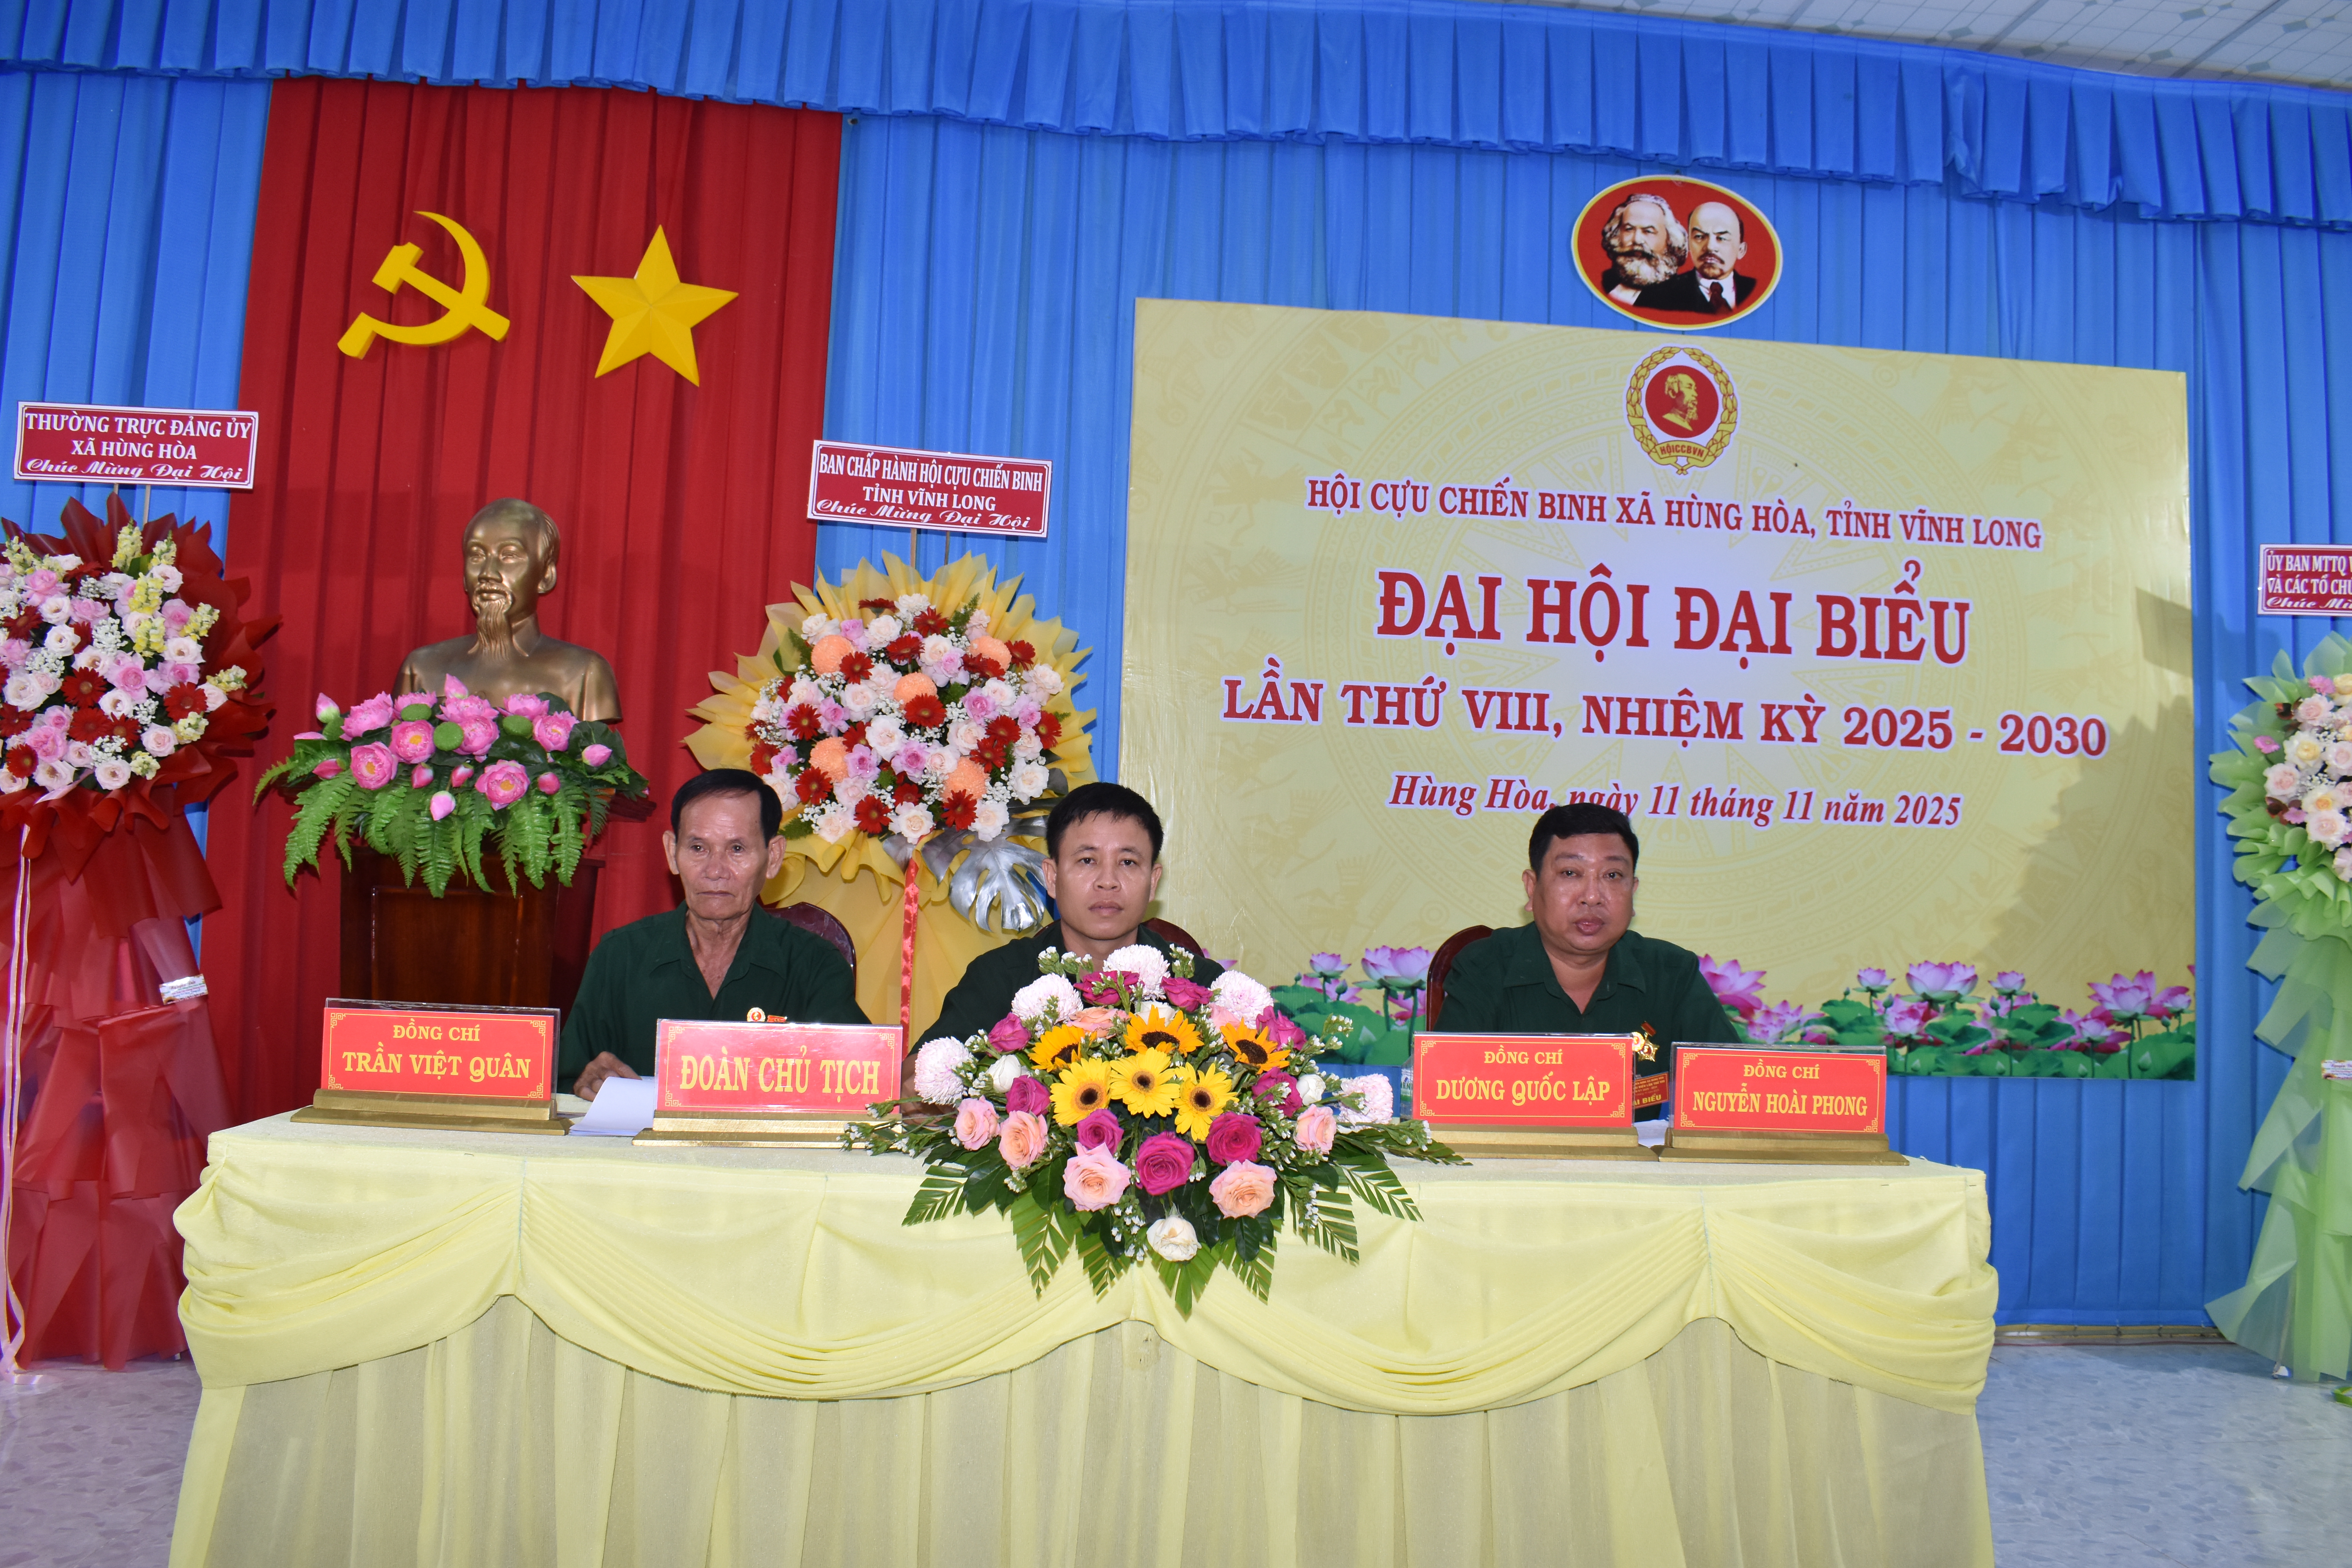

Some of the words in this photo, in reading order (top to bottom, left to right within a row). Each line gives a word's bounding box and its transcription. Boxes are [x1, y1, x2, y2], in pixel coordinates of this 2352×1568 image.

[25, 410, 109, 432] THƯỜNG
[115, 417, 166, 439] TRỰC
[170, 416, 221, 437] ĐẢNG
[227, 417, 252, 438] ỦY
[71, 437, 96, 456] XÃ
[101, 438, 153, 458] HÙNG
[158, 440, 197, 459] HÒA
[1660, 445, 1704, 457] HỘICCBVN
[27, 459, 78, 473] Chúc
[81, 460, 144, 479] Mừng
[150, 463, 193, 480] Đại
[200, 465, 243, 483] Hội
[819, 453, 846, 475] BAN
[847, 451, 880, 479] CHẤP
[882, 458, 917, 482] HÀNH
[919, 459, 942, 488] HỘI
[944, 465, 971, 490] CỰU
[973, 463, 1011, 489] CHIẾN
[1011, 471, 1043, 492] BINH
[863, 483, 904, 504] TỈNH
[907, 488, 949, 508] VĨNH
[952, 494, 996, 511] LONG
[1308, 474, 1360, 514] HỘI
[1371, 480, 1428, 517] CỰU
[1439, 477, 1528, 517] CHIẾN
[1539, 493, 1606, 522] BINH
[1616, 492, 1655, 525] XÃ
[1665, 494, 1742, 530] HÙNG
[1753, 499, 1815, 538] HÒA,
[1827, 501, 1890, 539] TỈNH
[1900, 509, 1964, 543] VĨNH
[1974, 519, 2041, 548] LONG
[817, 499, 866, 515] Chúc
[870, 504, 933, 523] Mừng
[939, 510, 982, 527] Đại
[988, 513, 1031, 530] Hội
[2267, 550, 2283, 571] ỦY
[2285, 555, 2309, 571] BAN
[2312, 555, 2347, 576] MTTQ
[2267, 574, 2282, 593] VÀ
[2285, 574, 2308, 594] CÁC
[1377, 572, 1501, 655] ĐẠI
[1526, 563, 1649, 662] HỘI
[1674, 587, 1791, 669] ĐẠI
[1816, 560, 1969, 664] BIỂU
[2267, 597, 2317, 608] Chúc
[1224, 657, 1323, 721] LẦN
[1341, 676, 1446, 727] THỨ
[1462, 690, 1562, 739] VIII,
[1583, 688, 1743, 748] NHIỆM
[1761, 693, 1826, 742] KỲ
[1844, 707, 1952, 749] 2025
[2001, 714, 2106, 756] 2030
[1390, 775, 1476, 815] Hùng
[1650, 786, 1679, 815] 11
[1691, 788, 1773, 826] tháng
[1785, 791, 1812, 819] 11
[1825, 795, 1884, 822] năm
[1895, 795, 1960, 825] 2025
[393, 1018, 443, 1040] ĐỒNG
[448, 1024, 481, 1042] CHÍ
[342, 1041, 403, 1073] TRẦN
[409, 1049, 462, 1080] VIỆT
[469, 1052, 531, 1083] QUÂN
[1484, 1045, 1529, 1064] ĐỒNG
[1534, 1049, 1563, 1064] CHÍ
[1744, 1058, 1787, 1078] ĐỒNG
[1792, 1064, 1820, 1079] CHÍ
[680, 1047, 750, 1091] ĐOÀN
[759, 1046, 811, 1093] CHỦ
[819, 1060, 880, 1102] TỊCH
[1436, 1076, 1505, 1100] DƯƠNG
[1512, 1071, 1566, 1106] QUỐC
[1572, 1075, 1610, 1106] LẬP
[1693, 1082, 1761, 1112] NGUYỄN
[1766, 1089, 1807, 1114] HOÀI
[1812, 1095, 1867, 1116] PHONG
